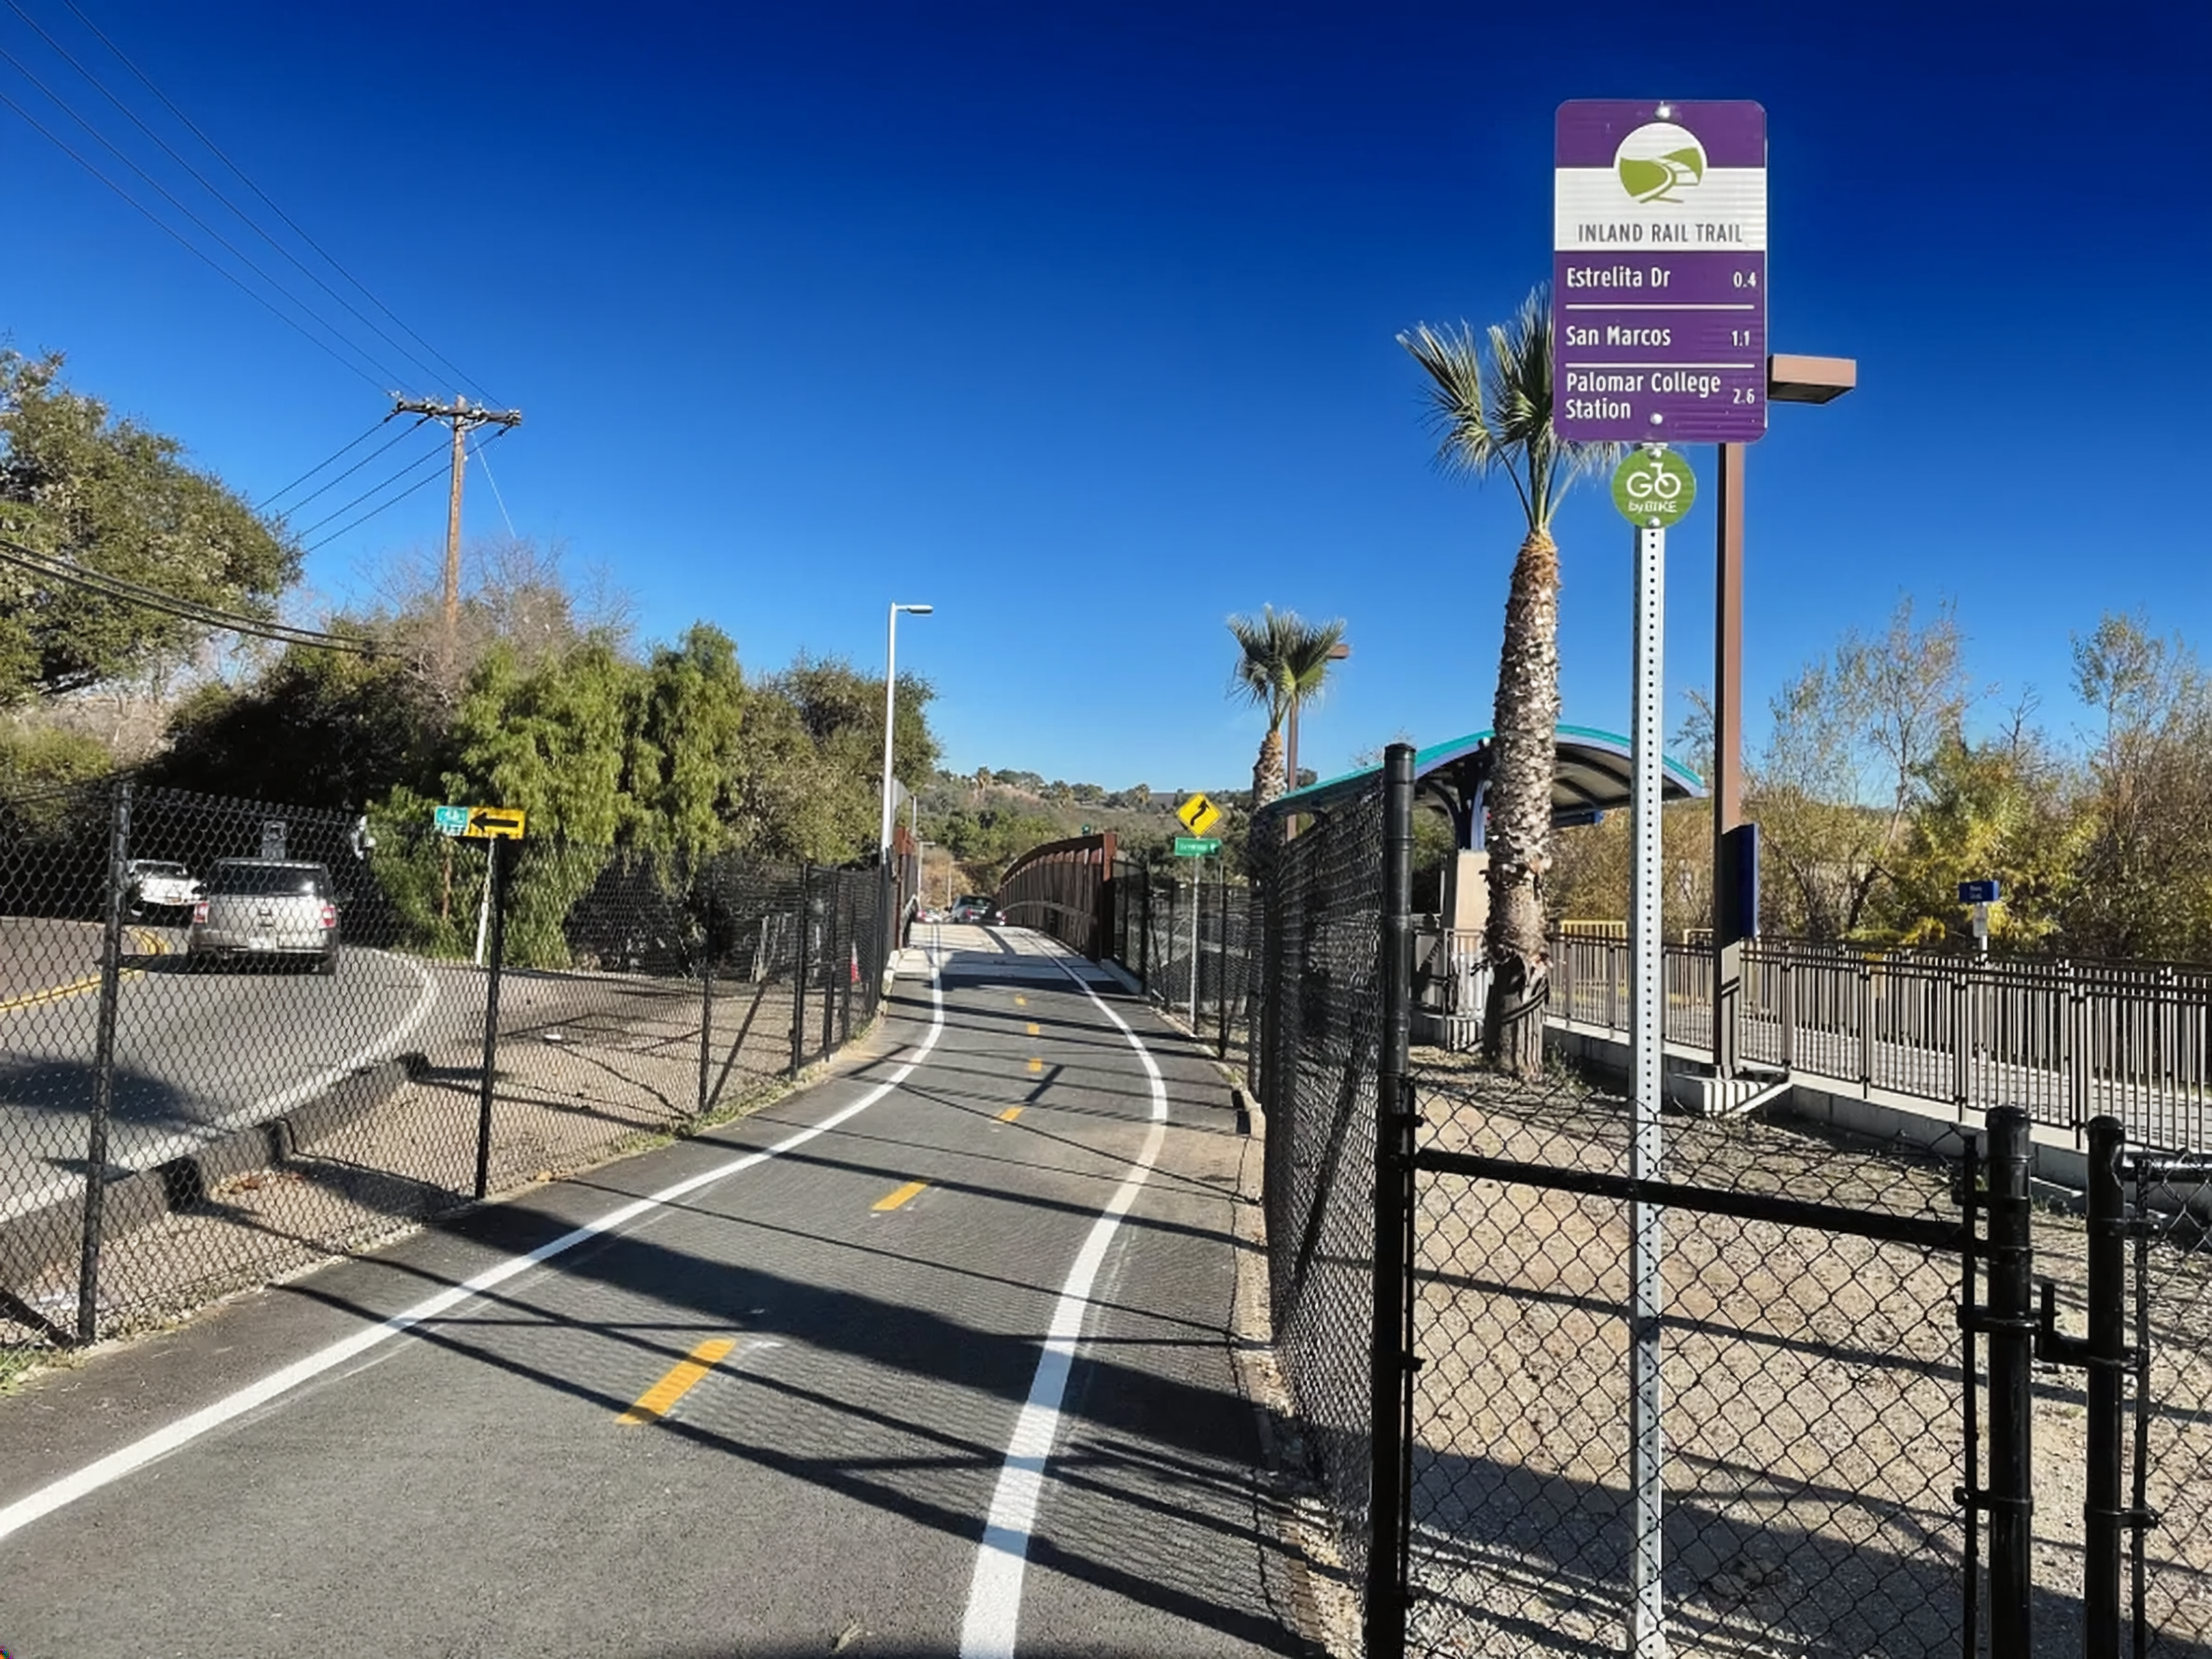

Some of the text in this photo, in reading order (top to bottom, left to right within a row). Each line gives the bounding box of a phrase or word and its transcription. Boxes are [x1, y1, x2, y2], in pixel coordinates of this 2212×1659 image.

[1578, 223, 1743, 243] INLAND RAIL TRAIL
[1567, 265, 1671, 288] Estrelita Dr
[1733, 271, 1757, 288] 0.4
[1566, 325, 1671, 346] San Marcos
[1731, 330, 1750, 347] 1.1
[1567, 371, 1721, 398] Palomar College
[1733, 388, 1755, 404] 2.6
[1565, 397, 1631, 419] Station
